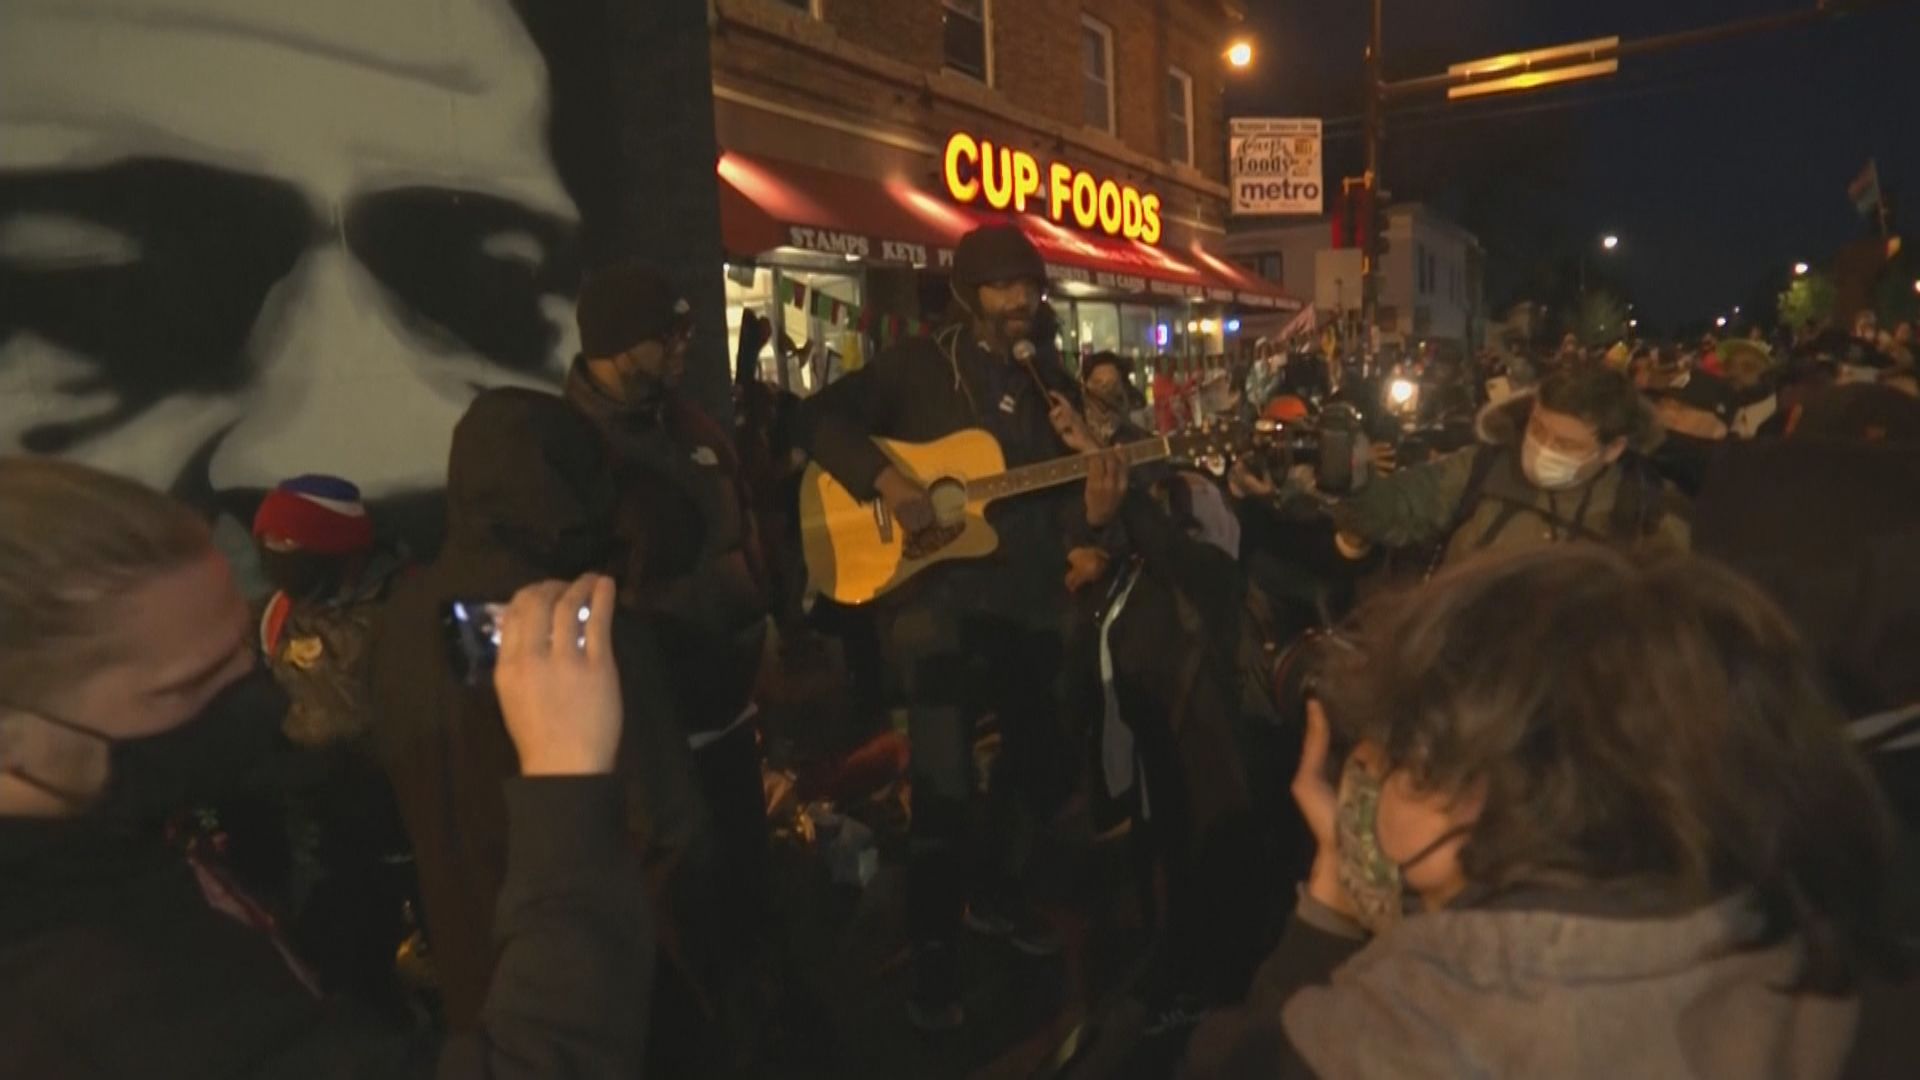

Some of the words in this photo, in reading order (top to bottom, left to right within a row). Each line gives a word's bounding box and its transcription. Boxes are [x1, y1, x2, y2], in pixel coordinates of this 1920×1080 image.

[945, 132, 1040, 212] CUP
[1050, 162, 1161, 243] FOODS
[1240, 179, 1319, 200] metro
[789, 226, 869, 256] STAMPS
[882, 240, 927, 264] KEYS
